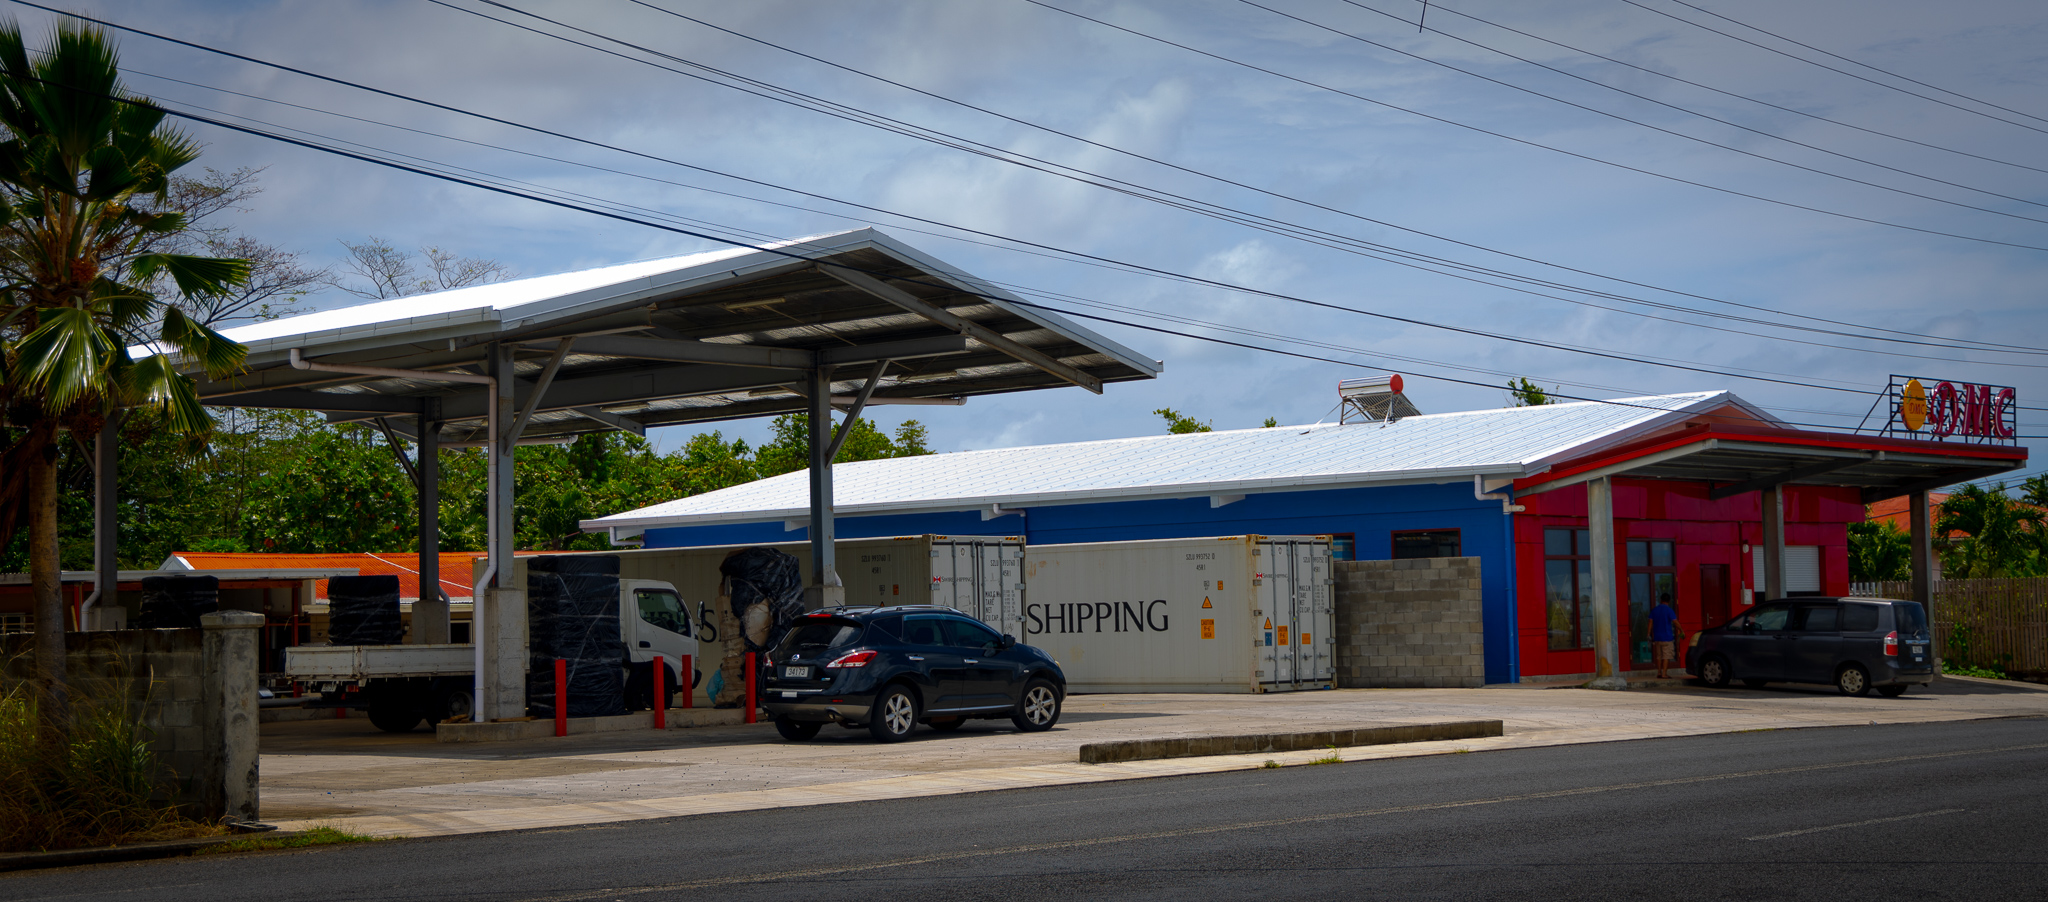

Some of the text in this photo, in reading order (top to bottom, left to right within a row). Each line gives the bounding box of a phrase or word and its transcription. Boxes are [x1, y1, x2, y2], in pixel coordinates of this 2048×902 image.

[1931, 381, 2013, 440] DMC
[1185, 553, 1195, 561] SZLU
[1196, 552, 1210, 560] 993752
[1027, 600, 1169, 634] SHIPPING
[787, 668, 806, 676] 34173
